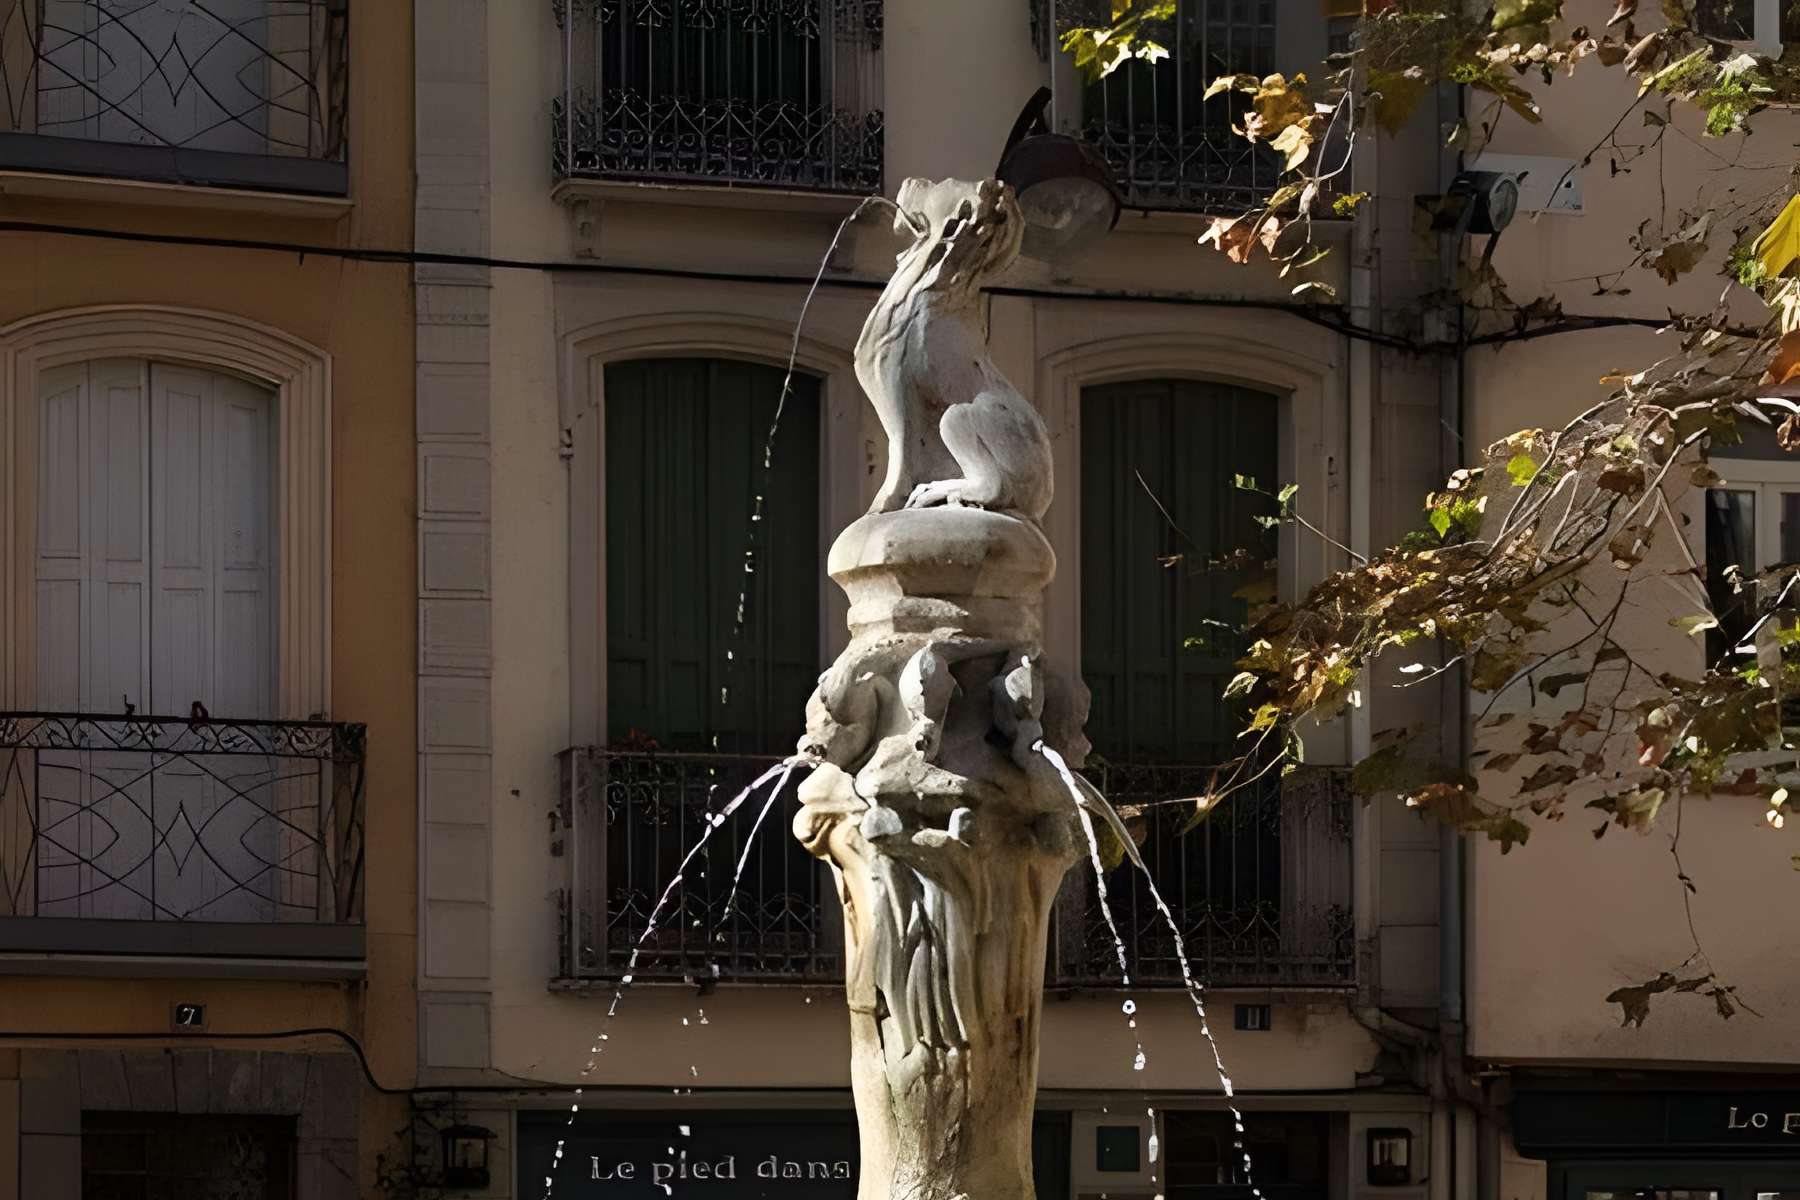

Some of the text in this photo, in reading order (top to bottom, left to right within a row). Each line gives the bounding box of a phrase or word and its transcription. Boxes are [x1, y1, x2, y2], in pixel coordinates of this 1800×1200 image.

[183, 1007, 195, 1025] 7
[589, 1156, 635, 1180] Le
[652, 1150, 737, 1188] pied
